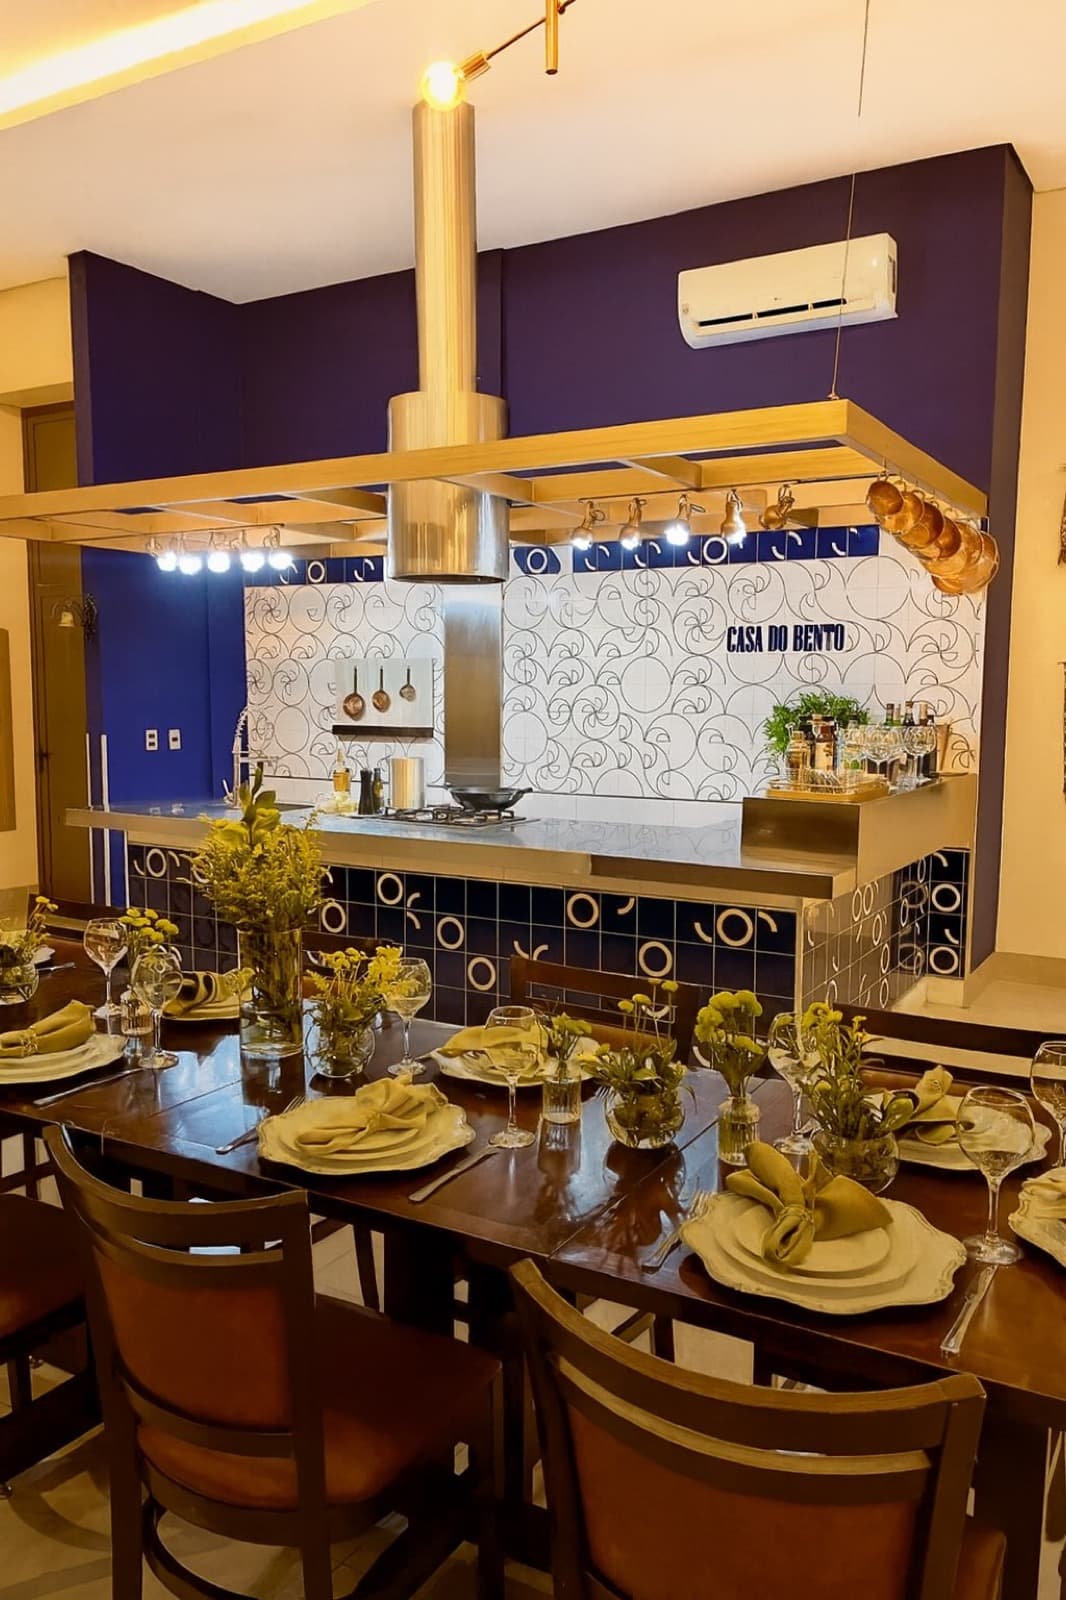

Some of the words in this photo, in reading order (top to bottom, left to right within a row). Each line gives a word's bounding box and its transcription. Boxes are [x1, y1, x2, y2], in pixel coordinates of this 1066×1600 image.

[726, 626, 763, 653] CASA
[767, 625, 788, 652] DO
[792, 624, 845, 652] BENTO
